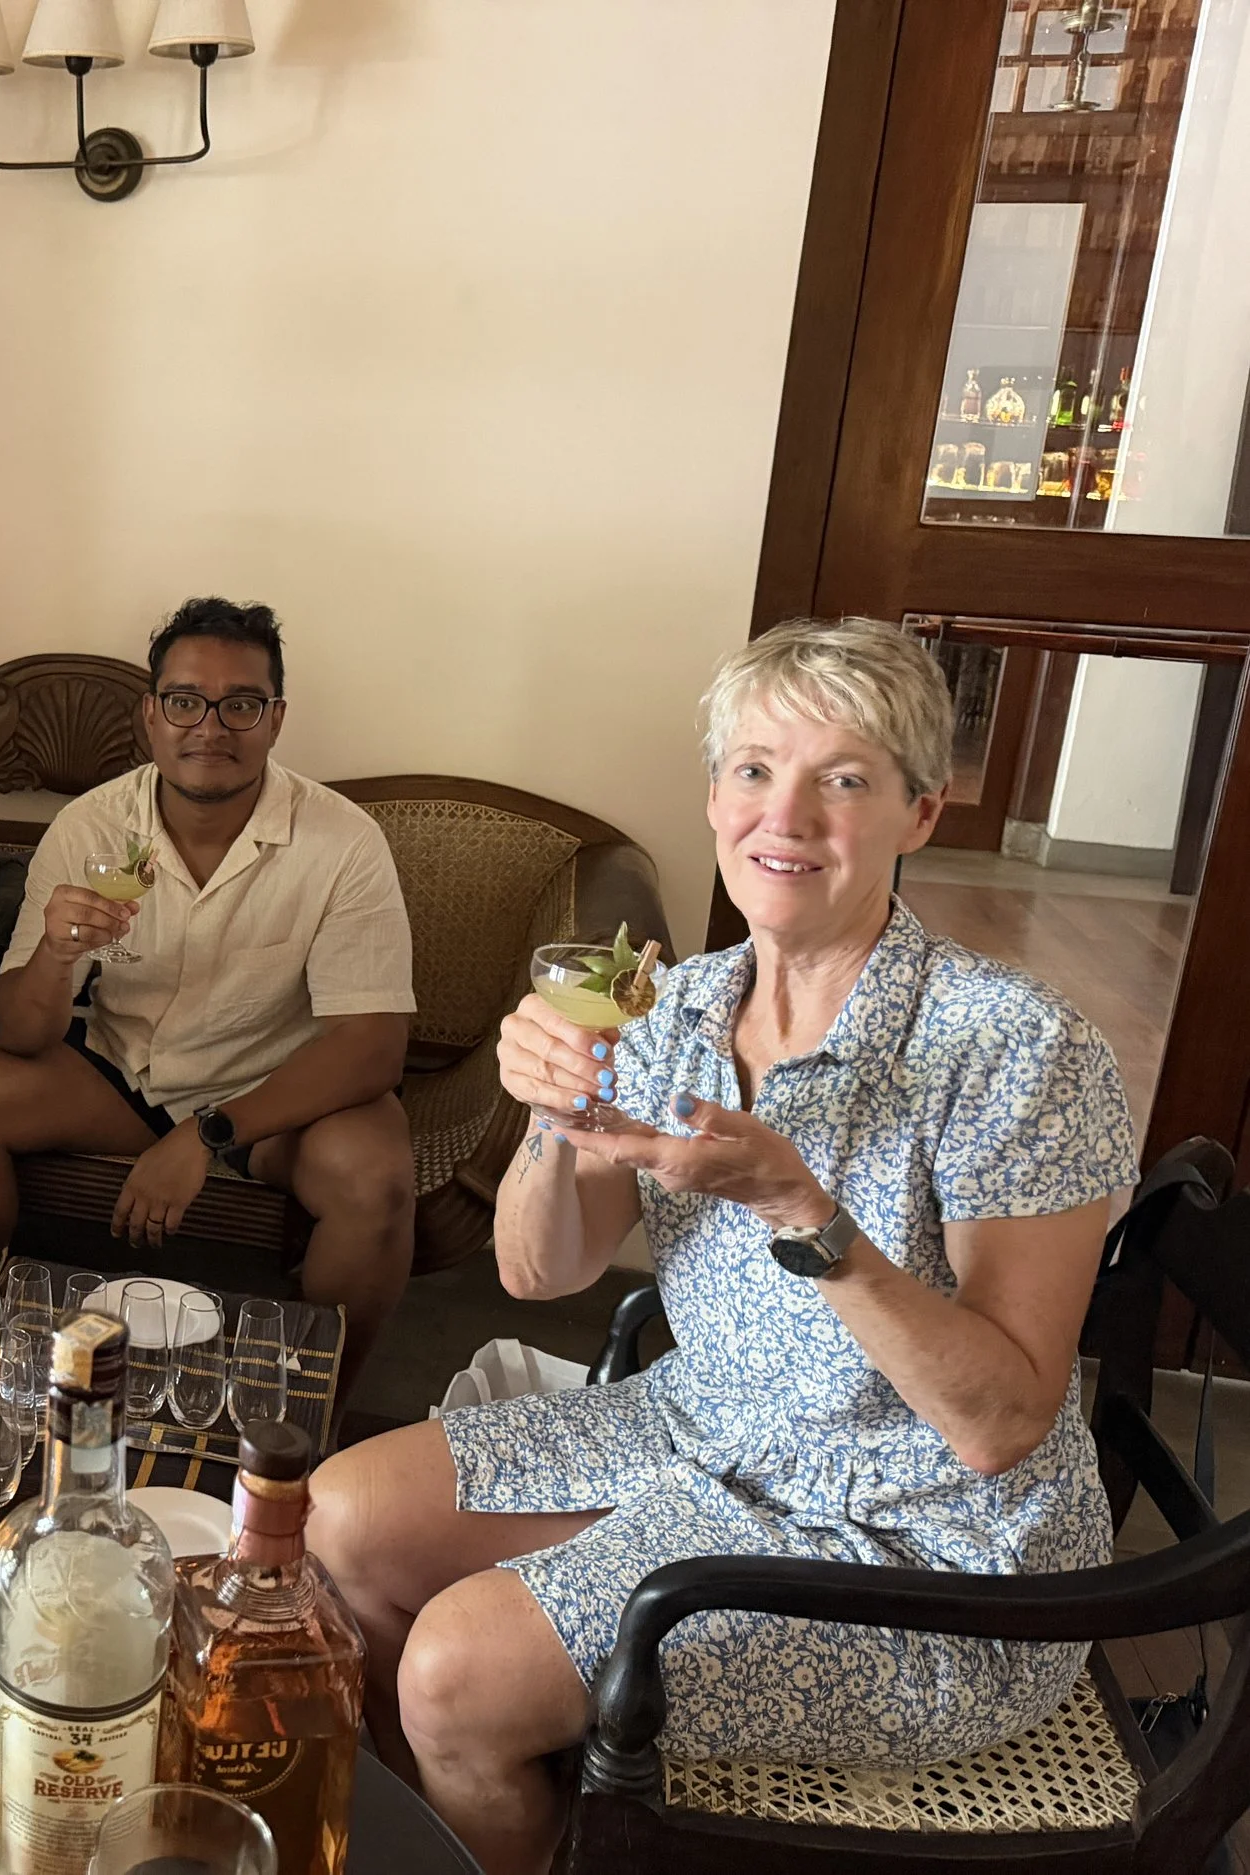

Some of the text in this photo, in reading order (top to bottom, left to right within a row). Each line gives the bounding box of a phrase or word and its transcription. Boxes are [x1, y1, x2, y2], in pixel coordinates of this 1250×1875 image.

[70, 1733, 92, 1746] 34
[63, 1774, 96, 1787] OLD
[33, 1778, 124, 1799] RESERVE
